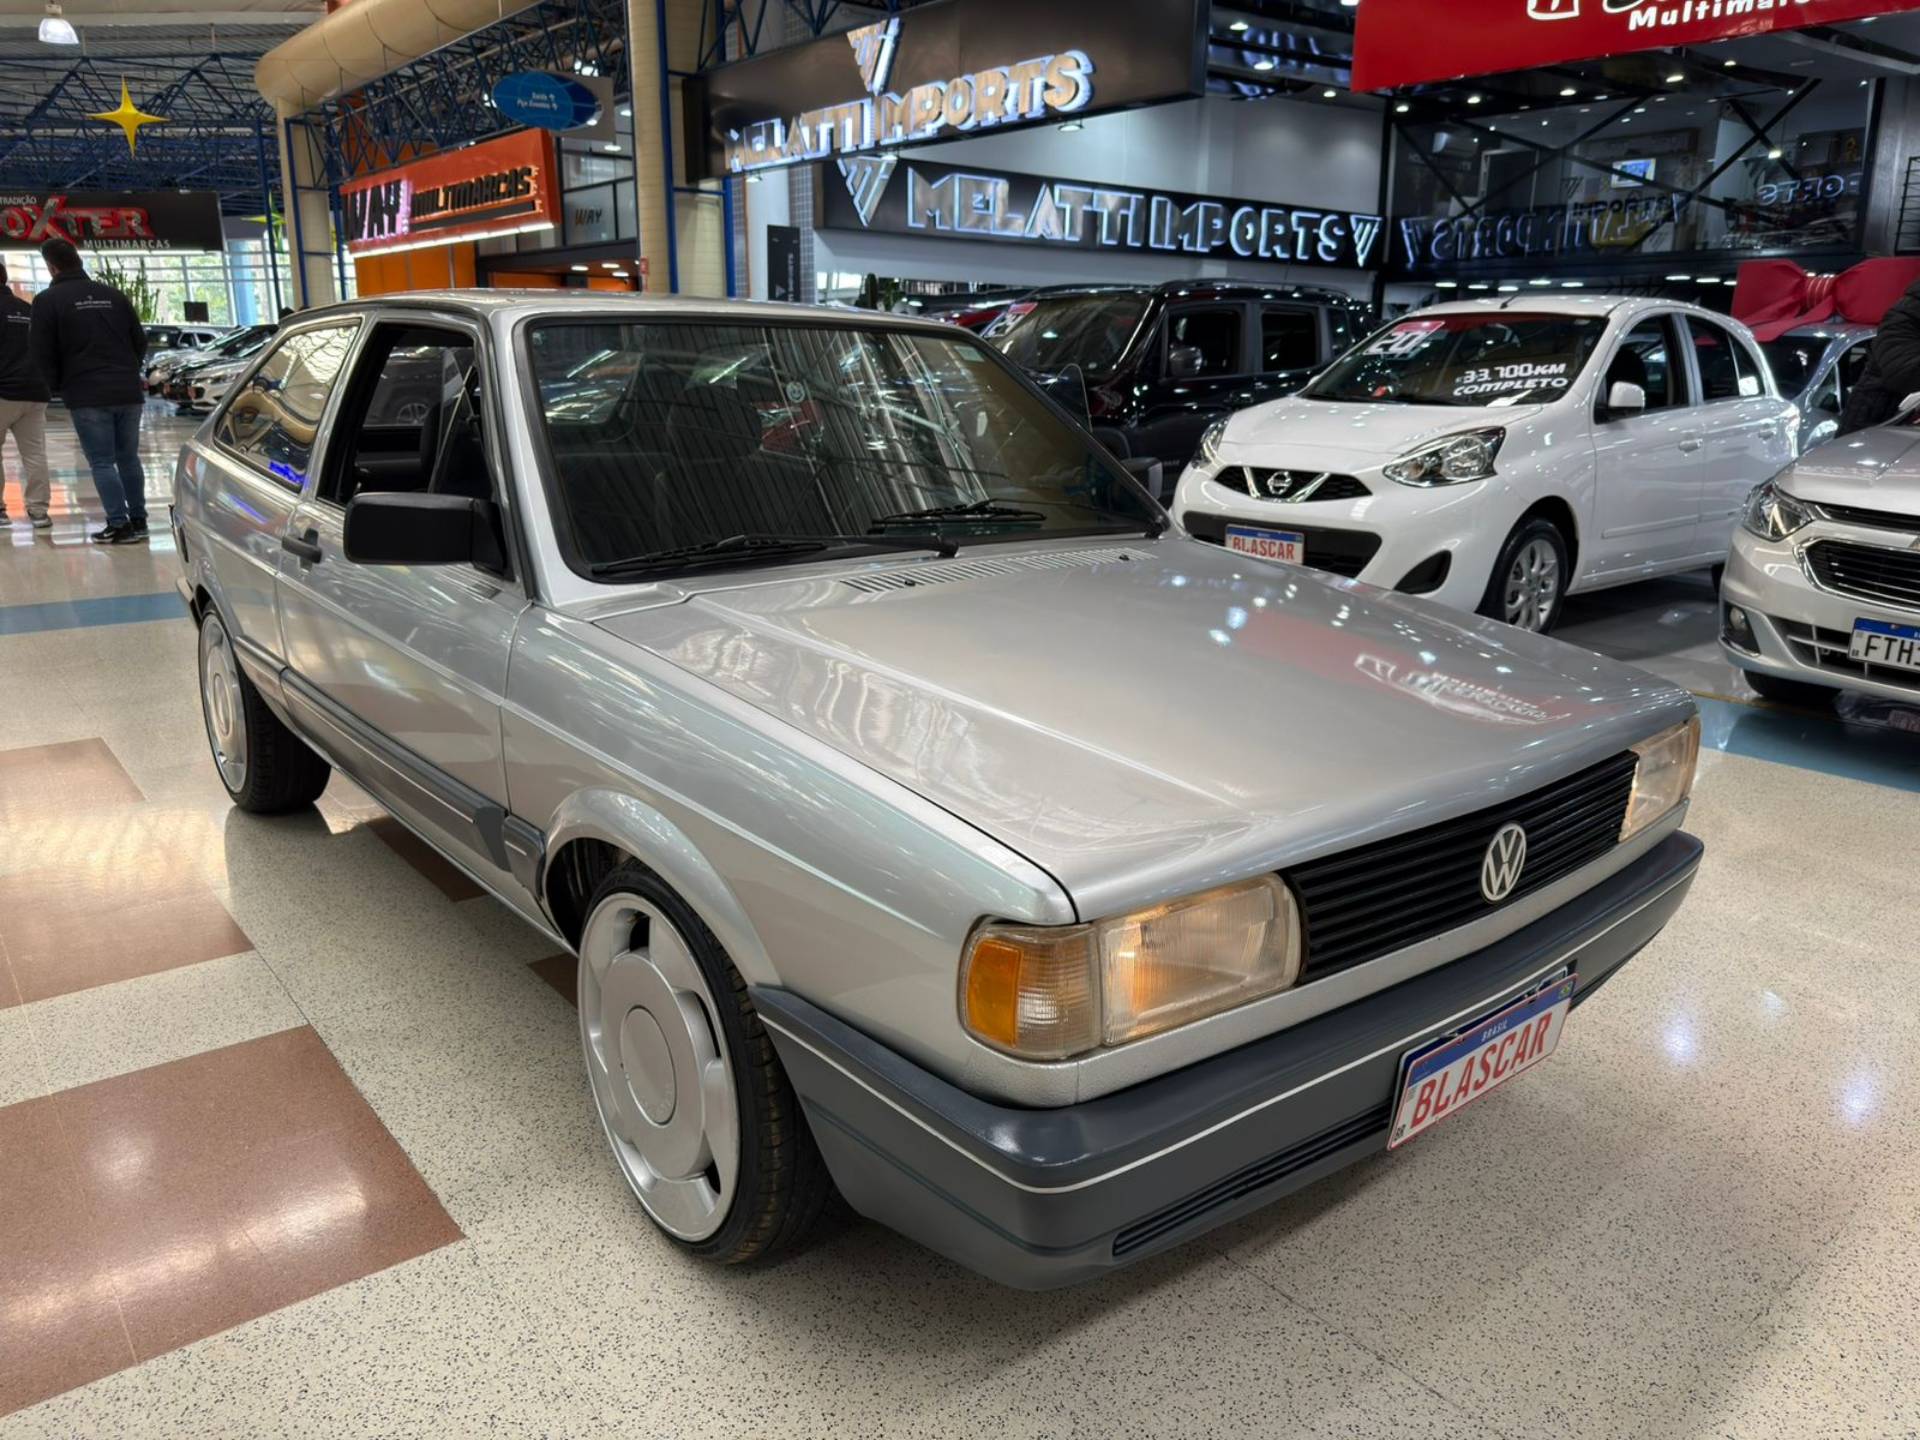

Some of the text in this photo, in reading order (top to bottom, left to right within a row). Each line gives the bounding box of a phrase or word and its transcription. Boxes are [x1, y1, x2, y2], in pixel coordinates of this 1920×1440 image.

[724, 50, 1094, 174] MELATTI IMPORTS
[575, 207, 603, 225] WAY
[907, 166, 1346, 262] MELATTI IMPORTS
[83, 239, 171, 249] MULTIMARCAS
[1453, 377, 1569, 396] COMPLETO
[1409, 1012, 1553, 1130] BLASCAR
